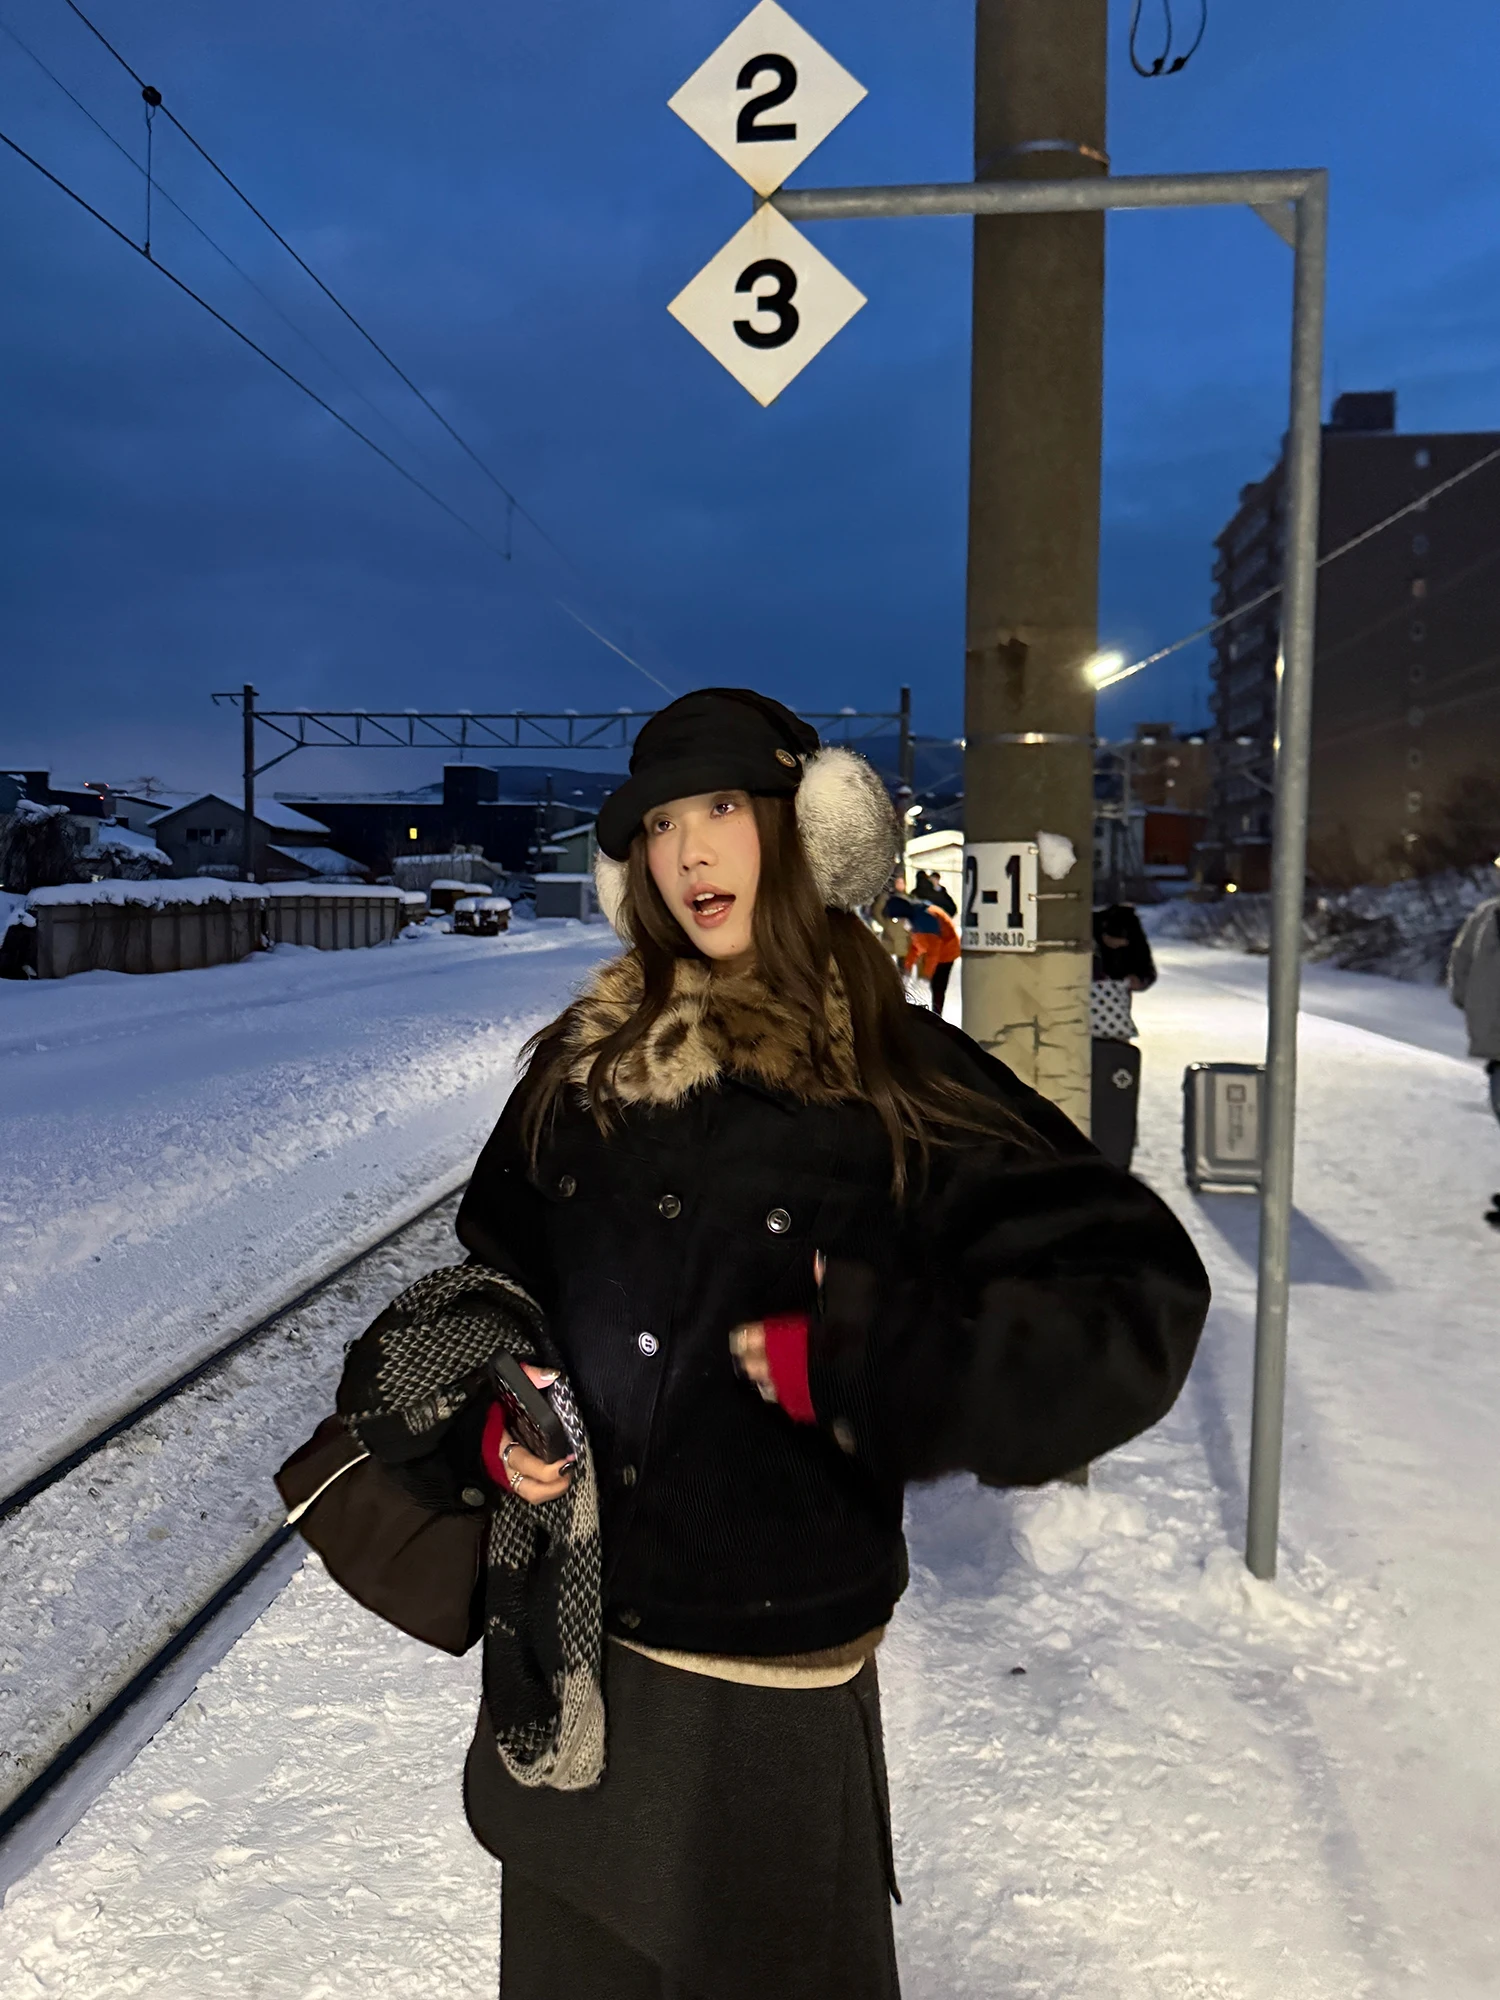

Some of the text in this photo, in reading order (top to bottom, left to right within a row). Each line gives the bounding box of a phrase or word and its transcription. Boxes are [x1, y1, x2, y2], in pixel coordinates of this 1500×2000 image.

[736, 53, 798, 143] 2
[733, 258, 800, 350] 3
[965, 855, 1024, 929] 2-1
